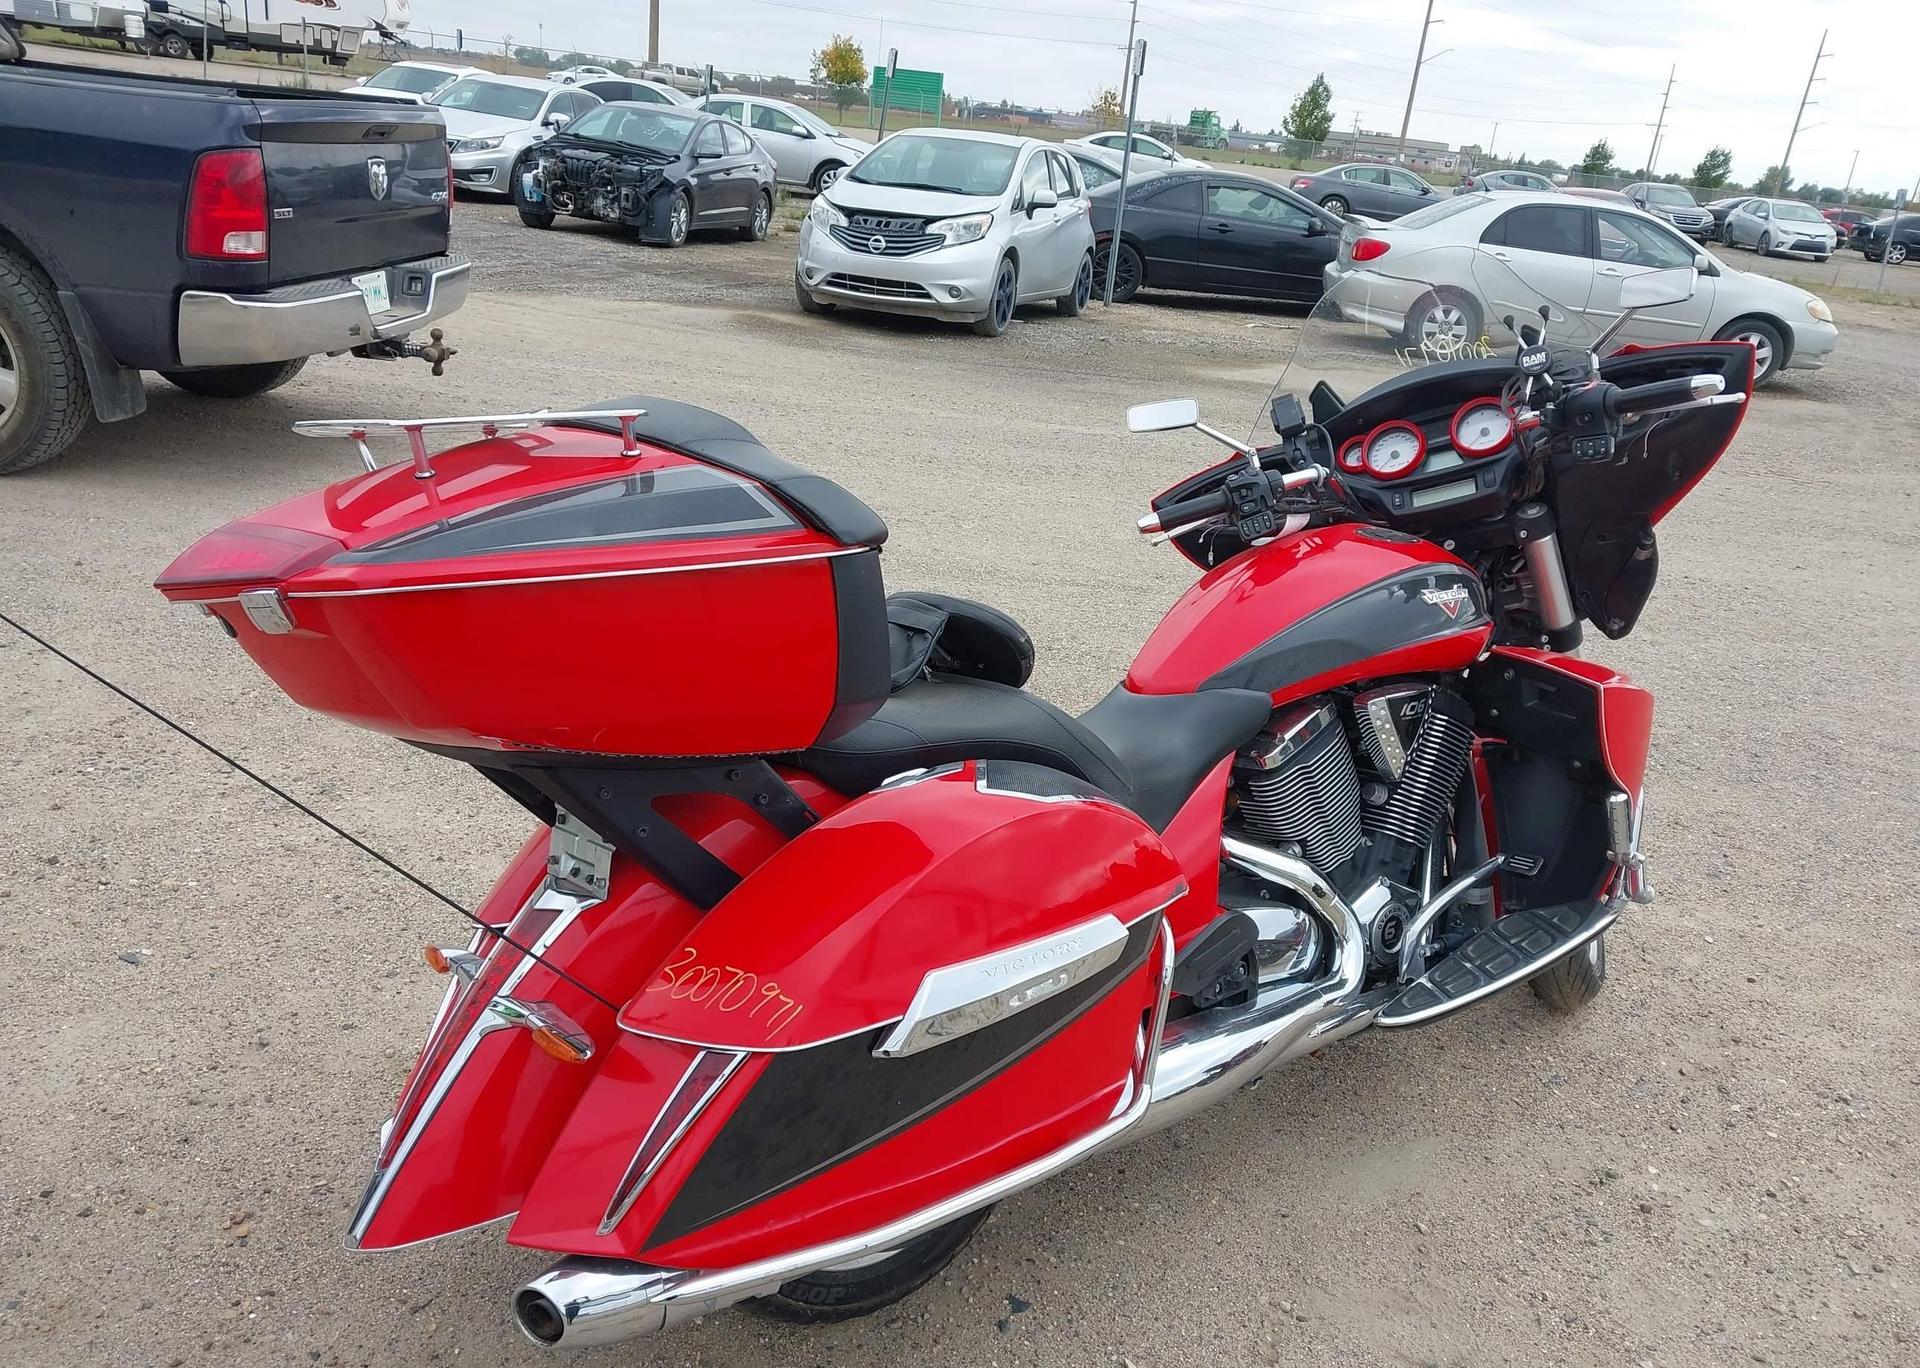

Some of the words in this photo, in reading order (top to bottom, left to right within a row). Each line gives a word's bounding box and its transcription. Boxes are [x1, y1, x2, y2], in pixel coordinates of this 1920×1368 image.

[275, 208, 293, 219] SLT
[1522, 351, 1546, 364] RAM
[1427, 589, 1468, 602] VICTORY
[1400, 698, 1427, 717] 106
[984, 936, 1085, 977] VICTORY
[645, 947, 804, 1042] 30070971
